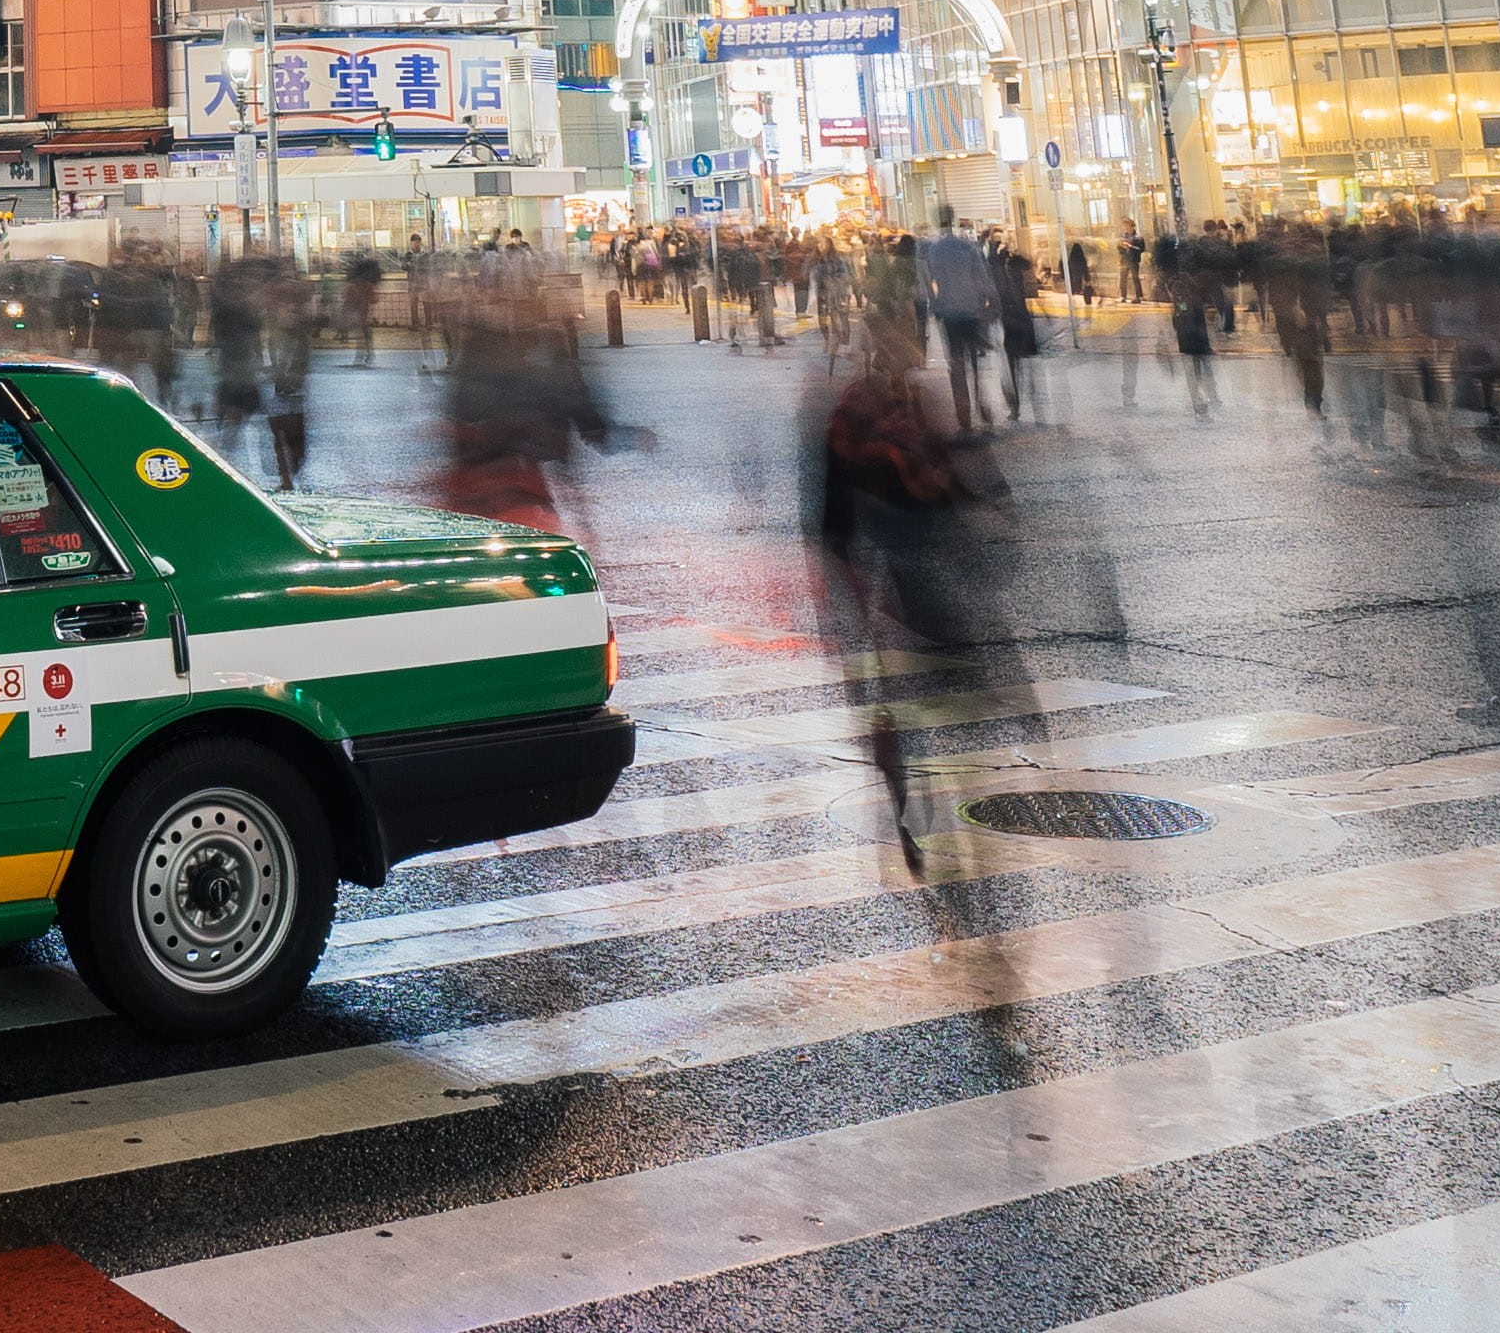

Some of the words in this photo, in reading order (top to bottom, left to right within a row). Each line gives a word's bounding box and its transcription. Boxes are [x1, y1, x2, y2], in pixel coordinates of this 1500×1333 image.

[721, 14, 895, 47] 全国交通安全運動実施中
[203, 53, 505, 116] 大盛堂書店
[1363, 135, 1432, 151] COFFEE
[63, 163, 160, 186] 三千里薬品
